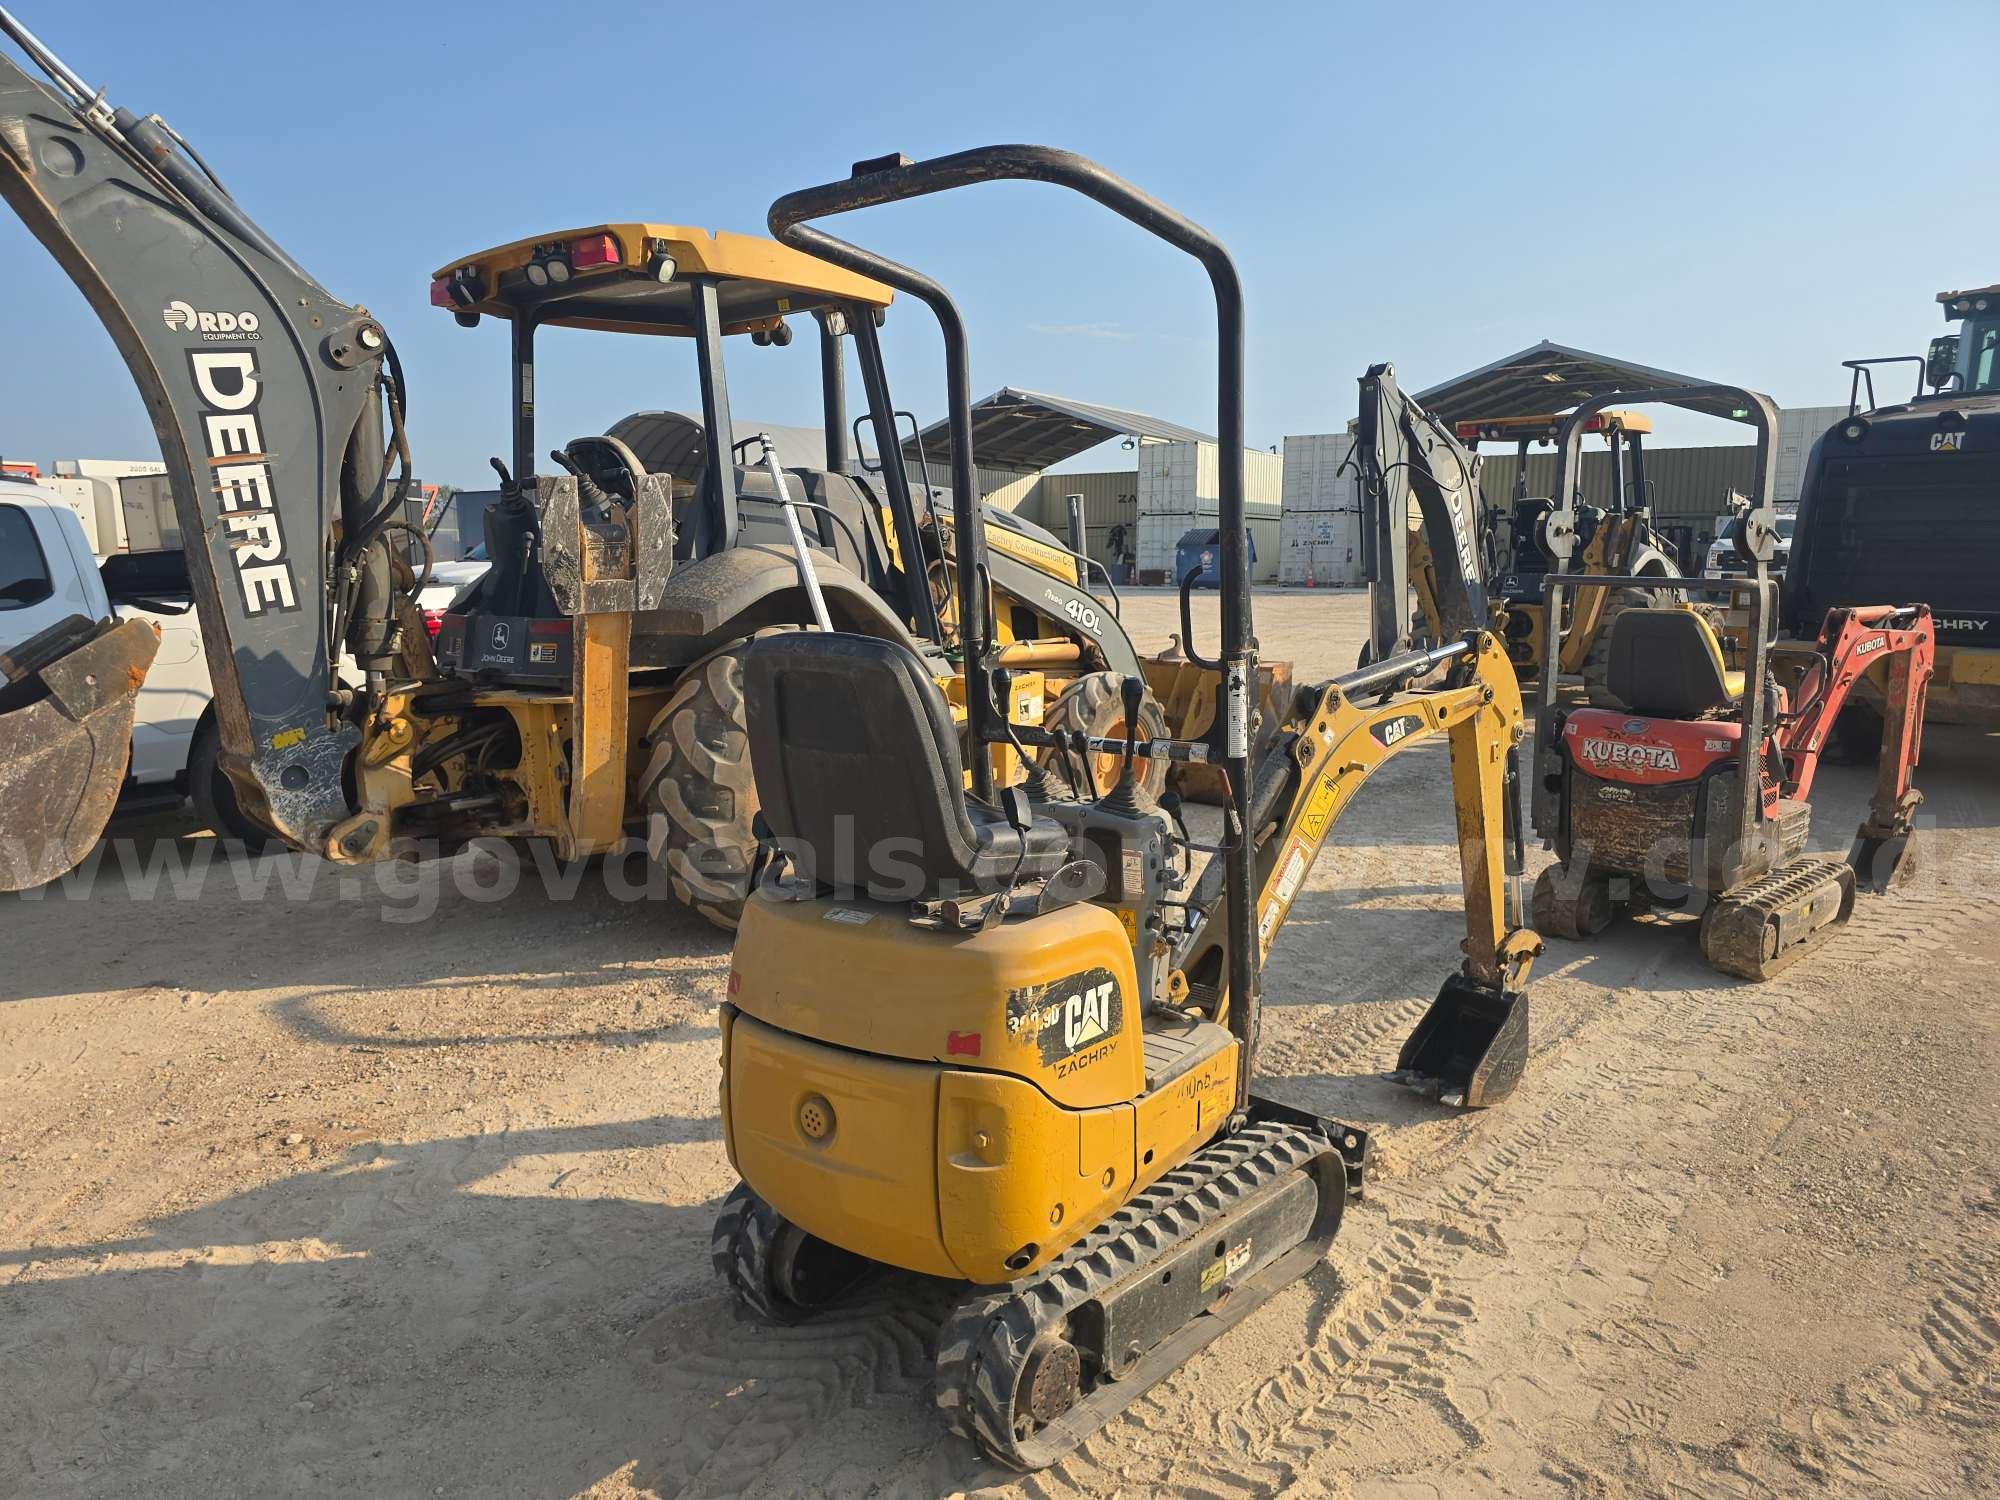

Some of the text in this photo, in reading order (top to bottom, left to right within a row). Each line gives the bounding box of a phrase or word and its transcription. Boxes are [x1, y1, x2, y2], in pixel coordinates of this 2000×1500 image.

[203, 333, 262, 341] EQUIPMENT CO.
[1930, 431, 1966, 452] CAT
[191, 352, 296, 613] DEERE
[1118, 494, 1137, 503] ZA
[1015, 541, 1063, 564] Construction
[1450, 491, 1478, 586] DEERE
[1064, 599, 1103, 637] 410L
[480, 654, 515, 664] JOHN DEERE
[1856, 635, 1886, 656] KUBOTA
[1384, 716, 1407, 746] CAT
[1582, 738, 1681, 772] KUBOTA
[1064, 981, 1114, 1049] CAT
[1057, 1041, 1118, 1081] ZACHRY
